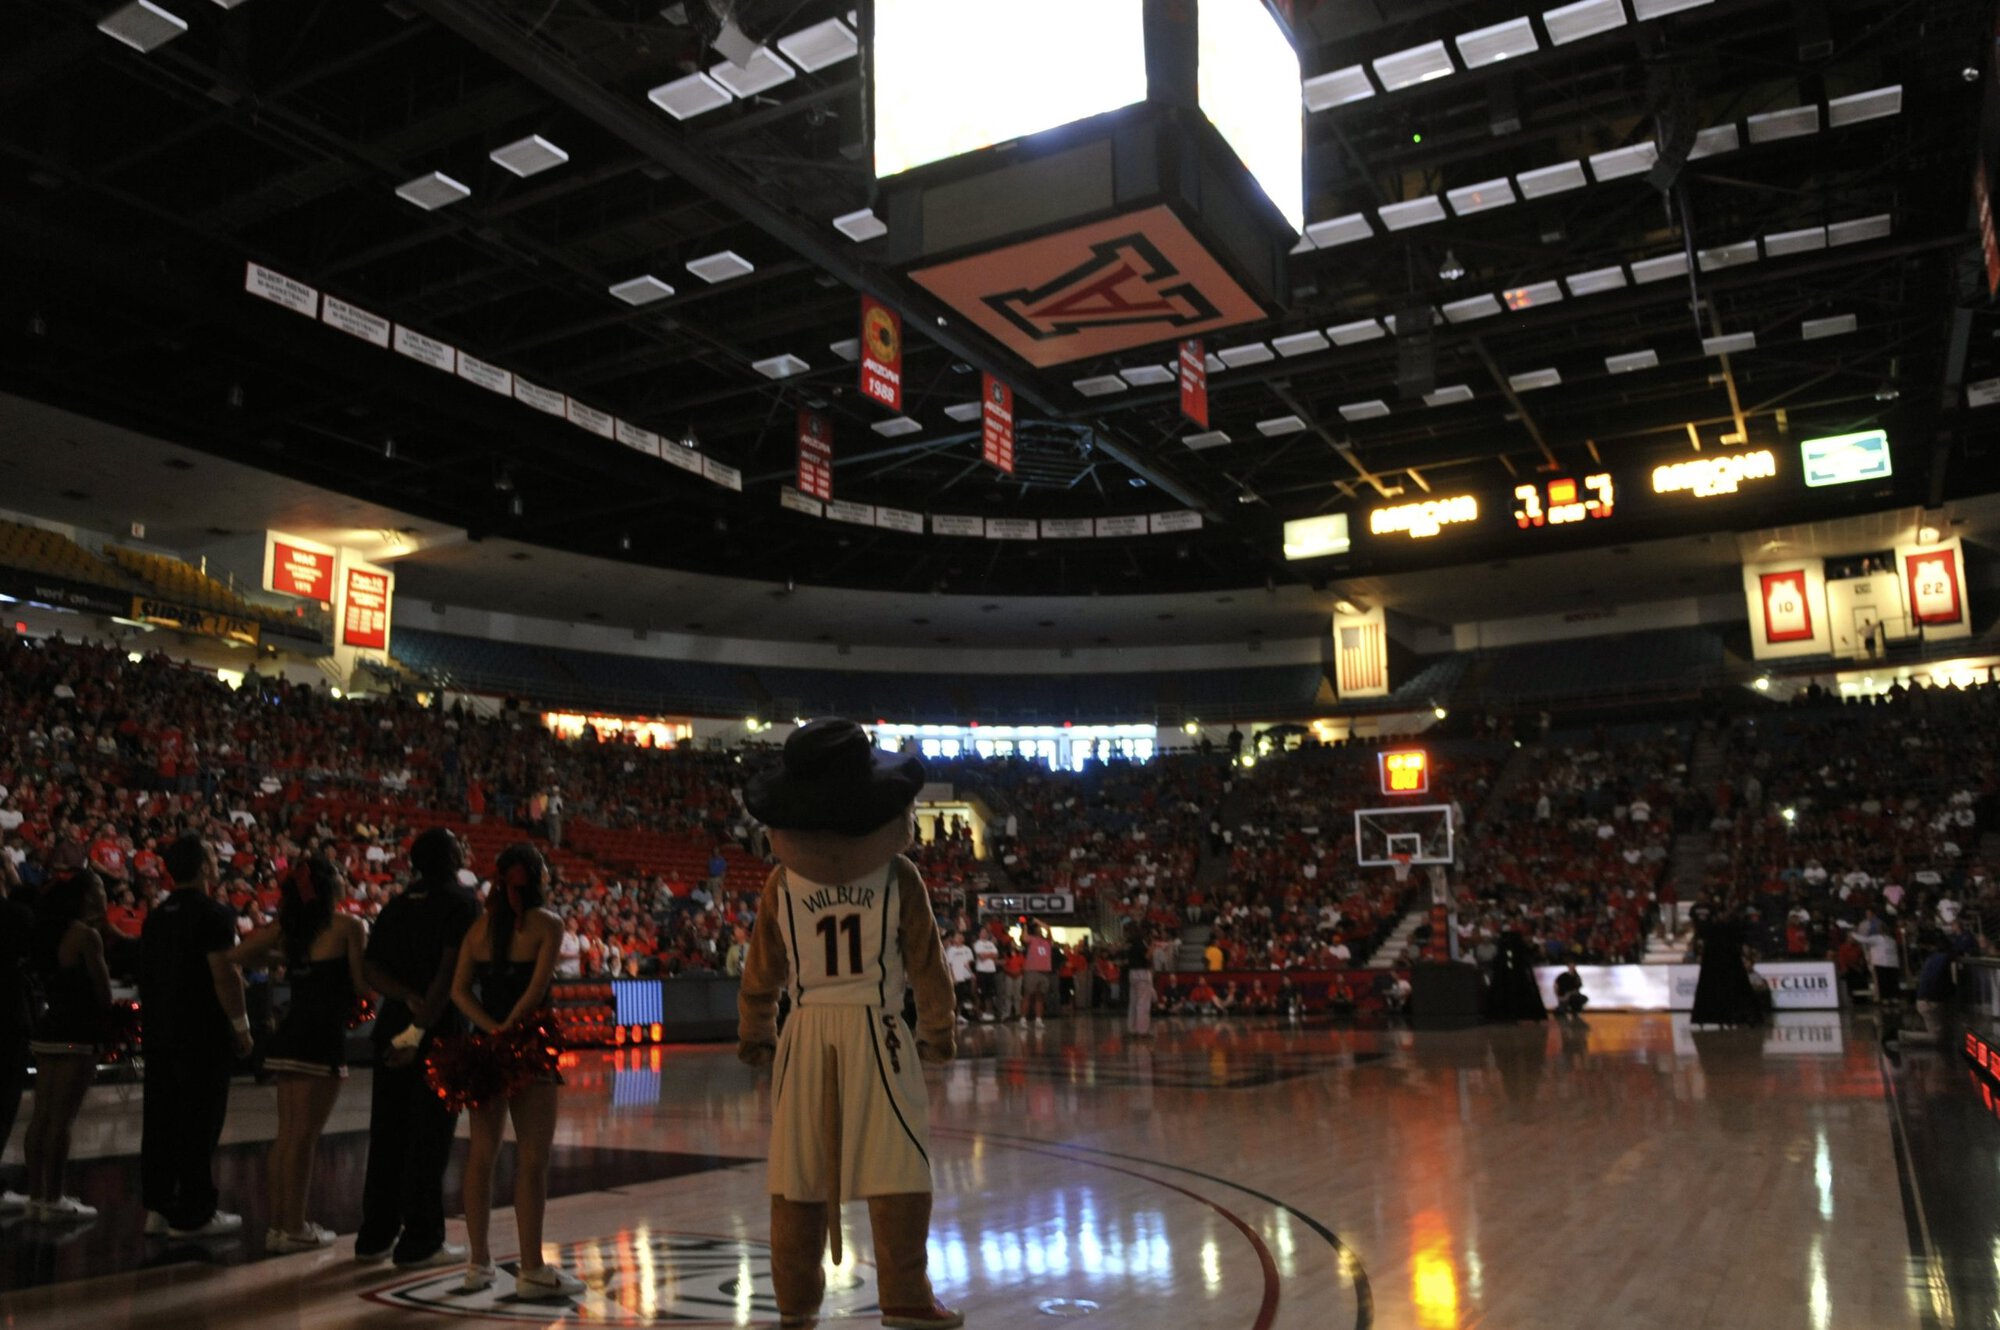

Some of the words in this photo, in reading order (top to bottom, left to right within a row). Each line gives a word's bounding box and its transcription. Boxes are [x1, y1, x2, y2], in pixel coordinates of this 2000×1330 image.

[1922, 582, 1945, 596] 22
[1778, 601, 1795, 613] 10
[802, 885, 875, 914] WILBUR
[987, 895, 1066, 912] GEICO
[816, 913, 863, 977] 11
